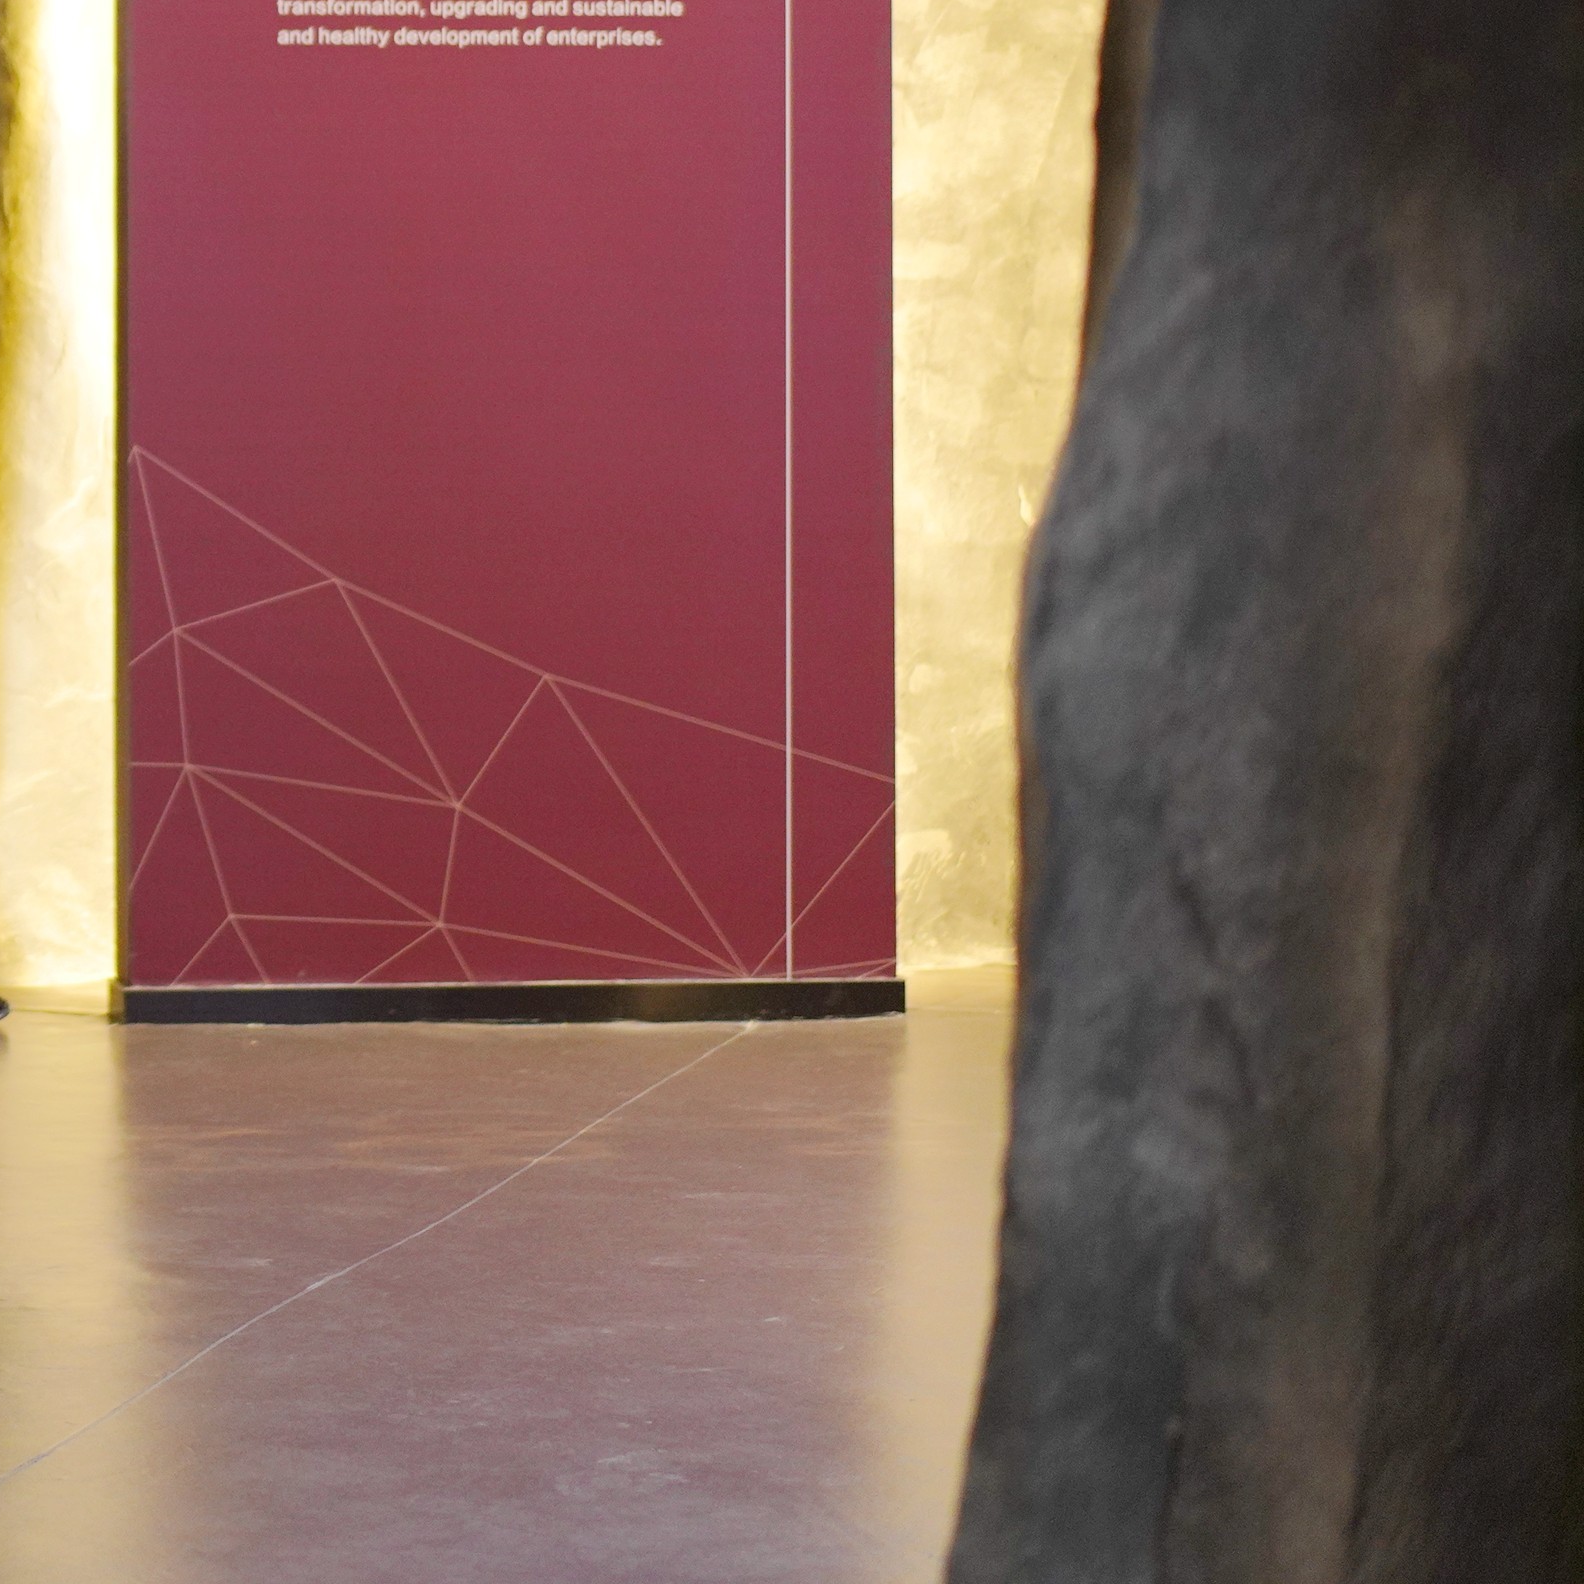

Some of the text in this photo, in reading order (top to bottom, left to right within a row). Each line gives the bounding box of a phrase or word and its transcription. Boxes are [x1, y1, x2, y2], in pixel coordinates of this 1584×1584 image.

[276, 26, 662, 49] and healthy development of enterprises.
